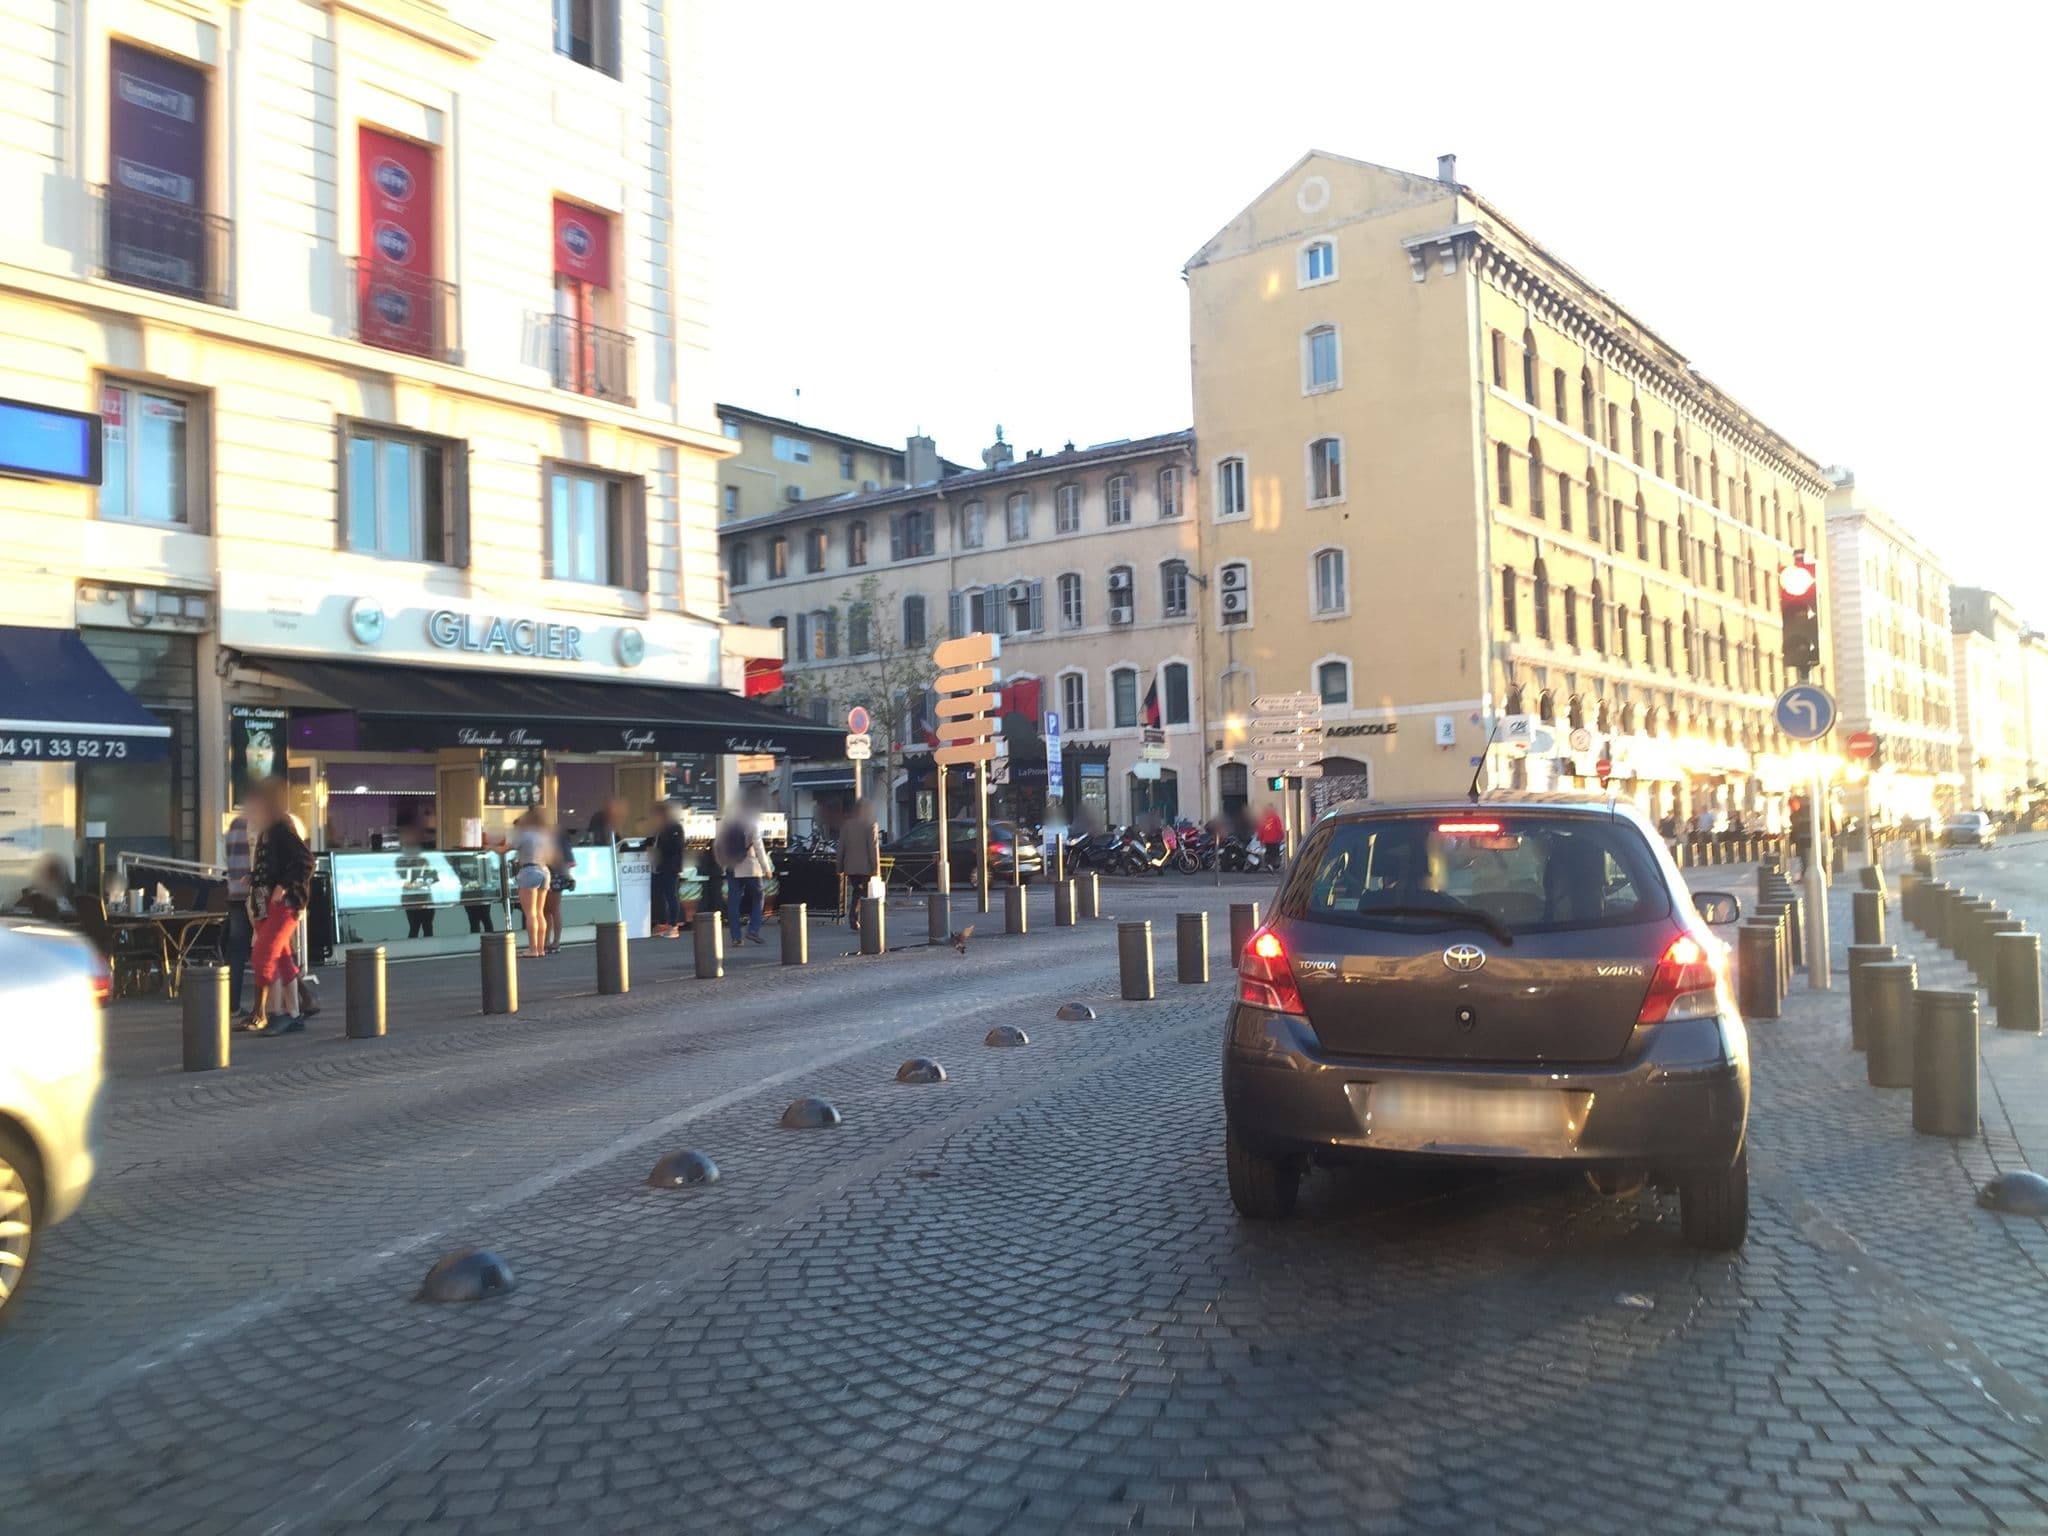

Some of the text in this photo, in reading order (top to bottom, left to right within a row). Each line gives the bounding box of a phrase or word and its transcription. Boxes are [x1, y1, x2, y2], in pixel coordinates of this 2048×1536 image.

[429, 609, 584, 661] GLACIER
[1326, 723, 1398, 738] AGRICOLE
[21, 738, 41, 755] 91
[48, 739, 72, 756] 33
[77, 740, 99, 757] 52
[105, 741, 127, 758] 73
[1299, 960, 1337, 971] TOYOTA
